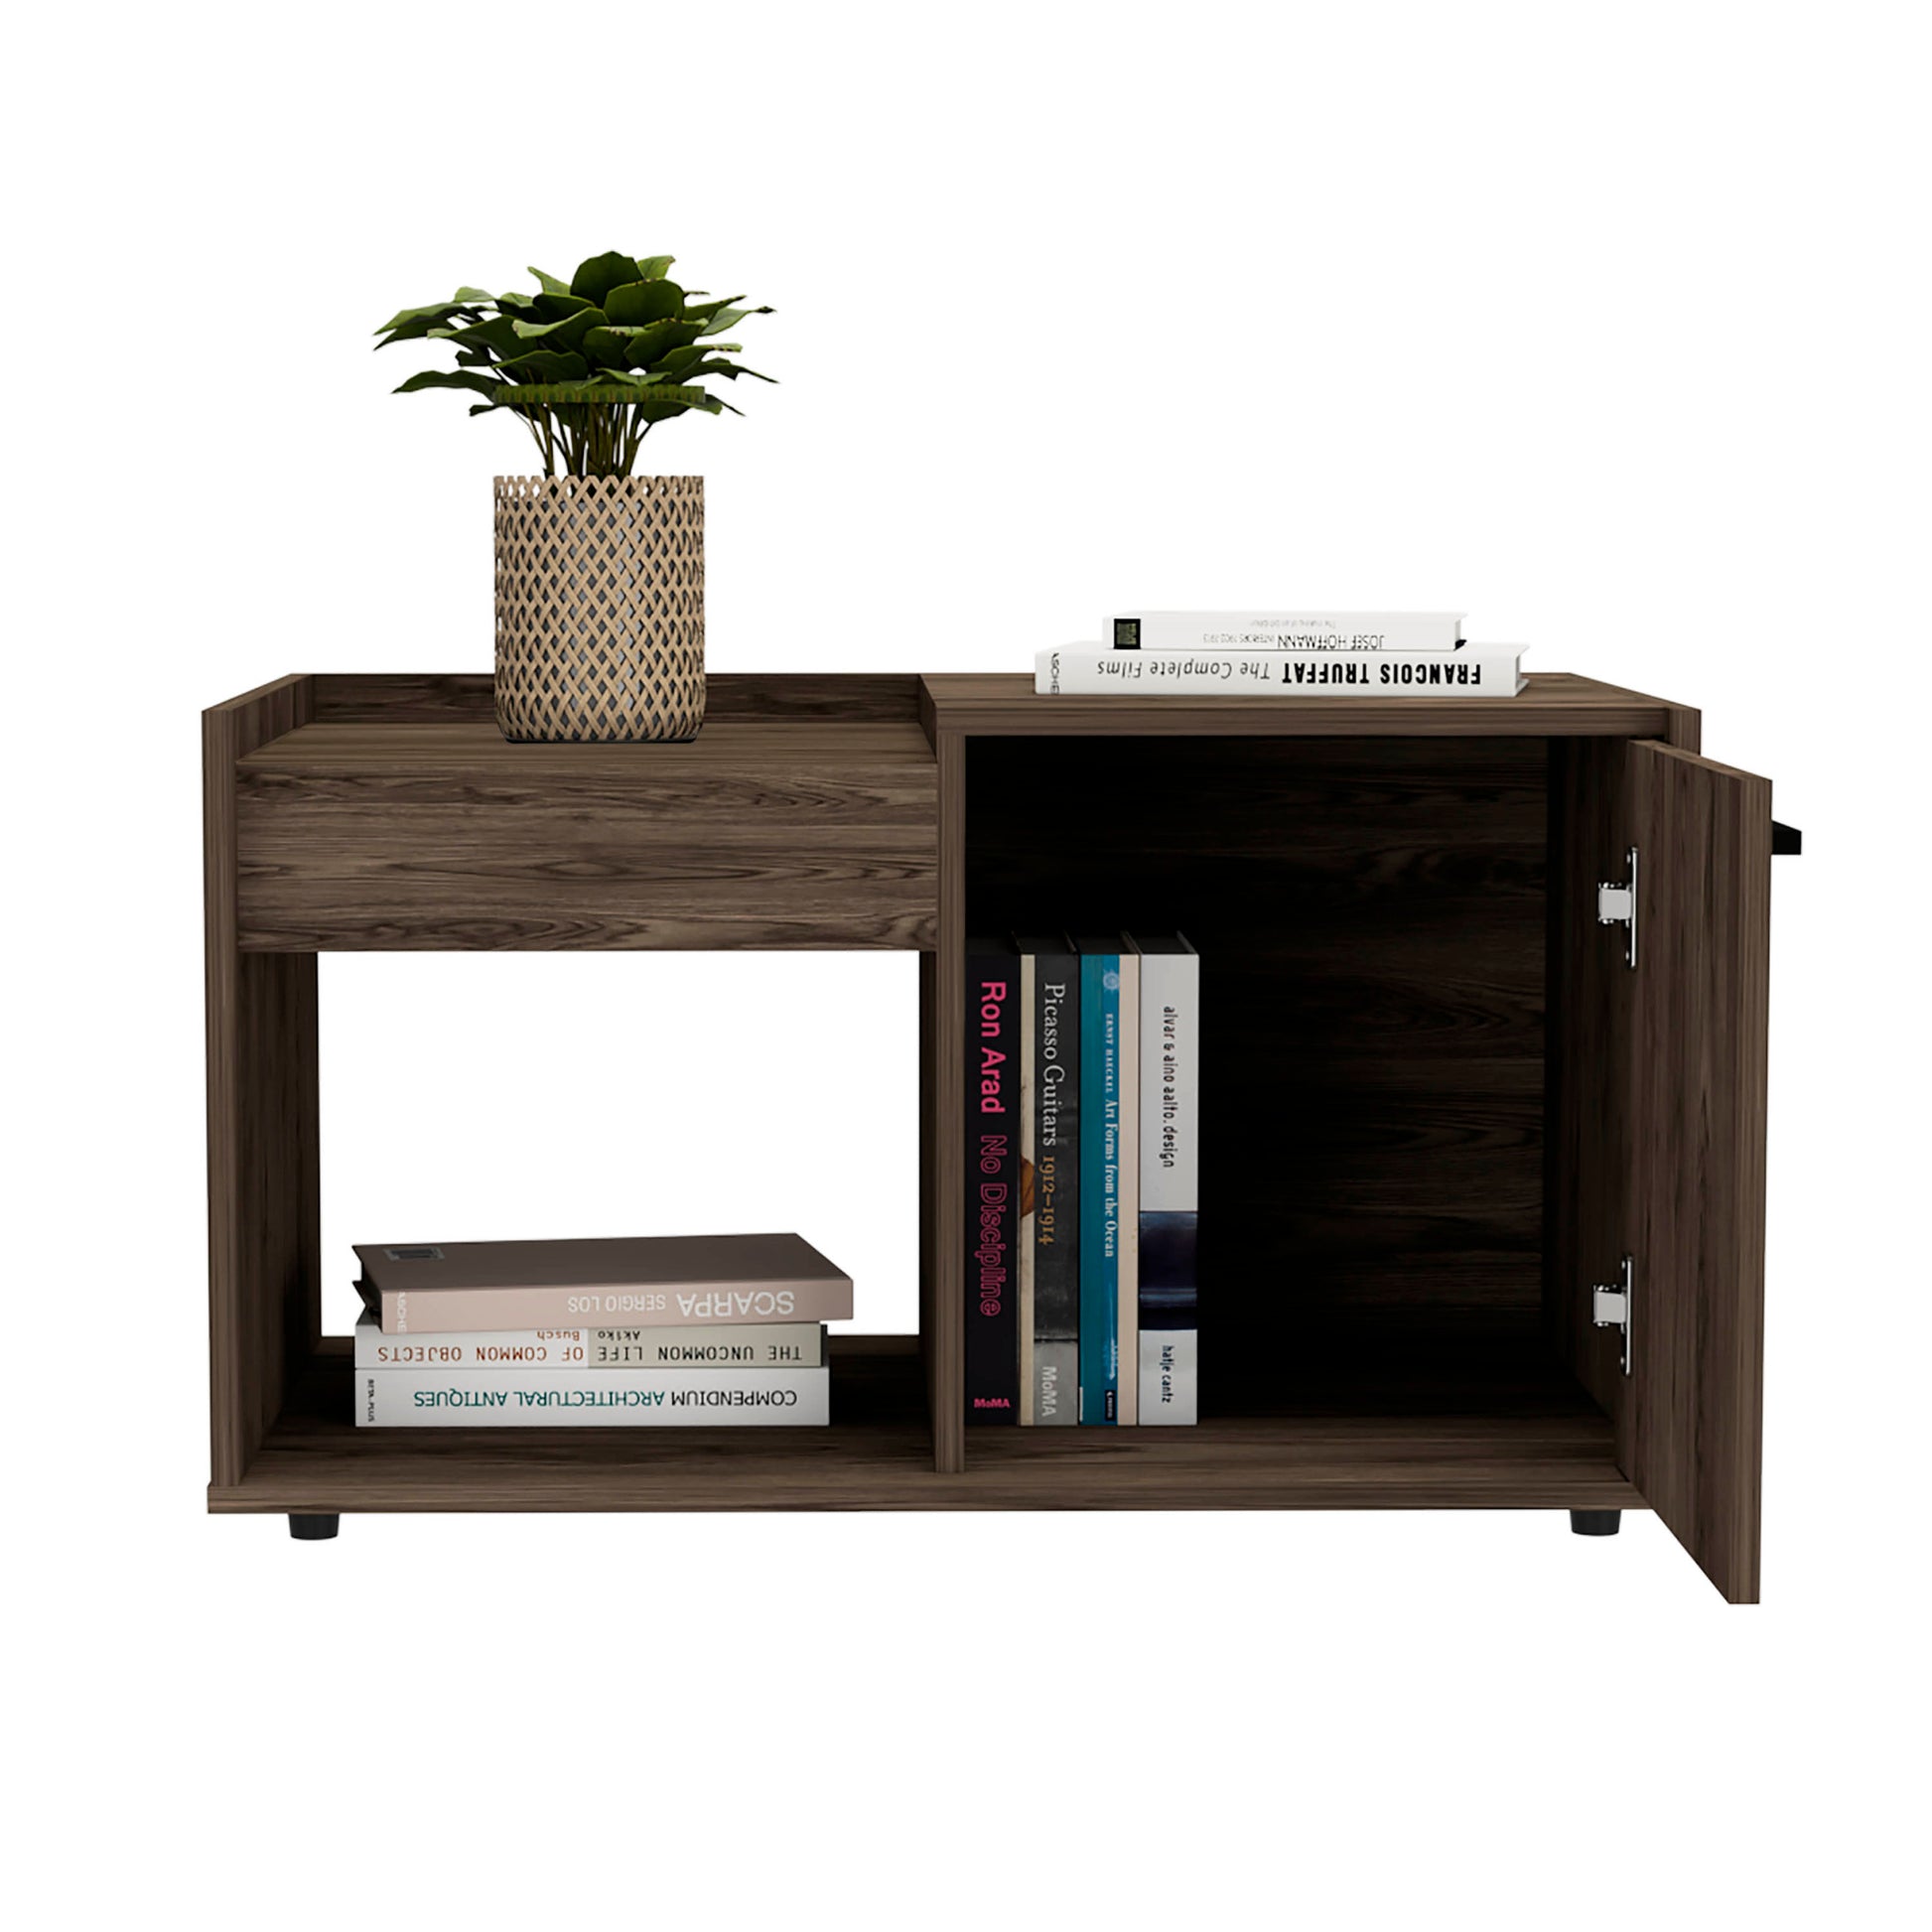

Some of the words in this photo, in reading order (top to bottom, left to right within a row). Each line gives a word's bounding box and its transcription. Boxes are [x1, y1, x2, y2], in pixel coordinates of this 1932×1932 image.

[1277, 634, 1347, 650] HOFFMANN
[1350, 634, 1385, 650] JOSEF
[1097, 660, 1143, 679] Films
[1150, 658, 1232, 680] Complete
[1240, 662, 1271, 680] The
[1282, 663, 1370, 684] TRUFFAT
[1380, 663, 1481, 685] FRANCOIS
[980, 981, 1007, 1037] Ron
[1042, 982, 1066, 1060] Picasso
[1163, 1006, 1178, 1041] alvar
[1163, 1053, 1178, 1083] aino
[980, 1046, 1007, 1113] Arad
[1042, 1065, 1065, 1147] Guitars
[1105, 1098, 1118, 1119] Art
[1105, 1123, 1119, 1161] Forms
[980, 1135, 1008, 1174] No
[1105, 1165, 1118, 1193] from
[1105, 1197, 1118, 1217] the
[974, 1182, 1008, 1316] Discipline
[1105, 1220, 1118, 1258] Ocean
[567, 1296, 601, 1313] LOS
[606, 1294, 667, 1312] SERGIO
[676, 1291, 795, 1317] SCARPA
[536, 1330, 581, 1341] Busch
[598, 1330, 640, 1341] Akiko
[377, 1346, 463, 1362] OBJECTS
[476, 1346, 547, 1361] COMMON
[561, 1346, 584, 1361] OF
[598, 1345, 643, 1361] LIFE
[657, 1345, 755, 1361] UNCOMMON
[767, 1345, 803, 1361] THE
[1159, 1345, 1174, 1372] hatje
[413, 1388, 508, 1407] ANTIQUES
[512, 1391, 665, 1407] ARCHITECTURAL
[671, 1390, 797, 1407] COMPENDIUM
[1041, 1365, 1057, 1418] MoMA
[1161, 1374, 1174, 1404] cantz
[973, 1397, 1011, 1409] MoMA
